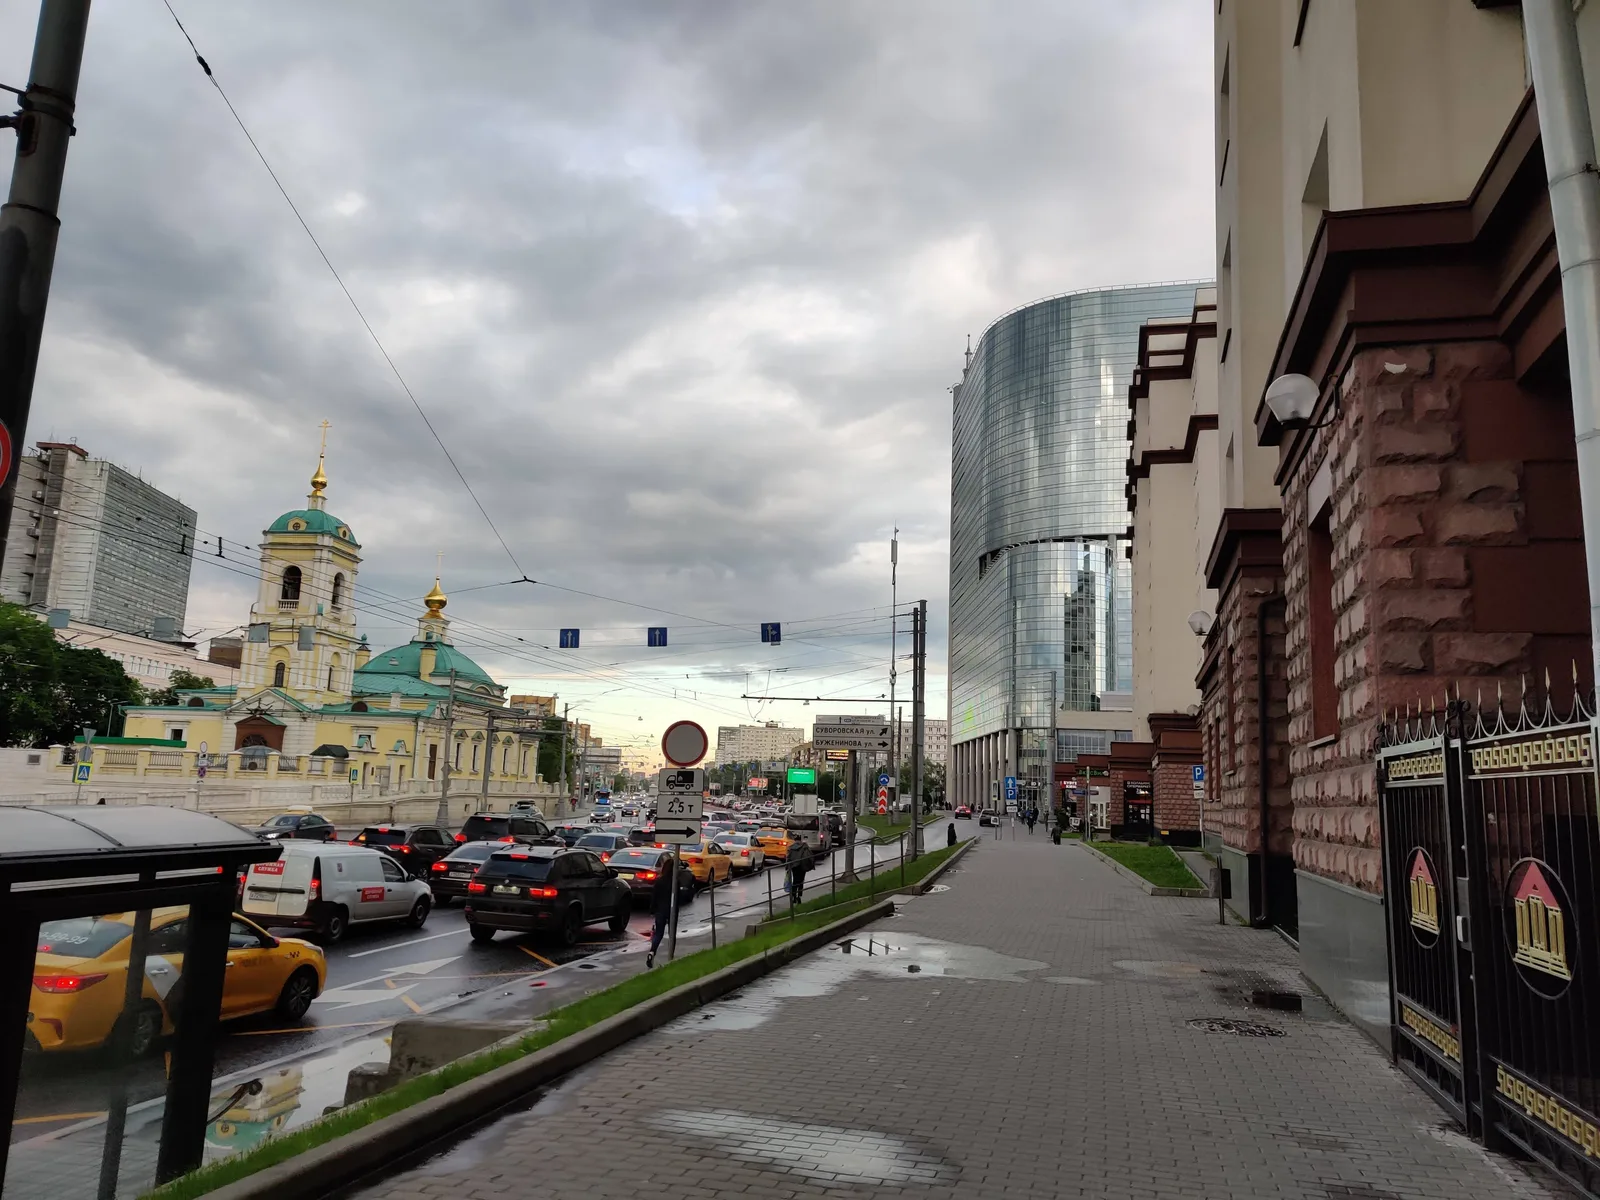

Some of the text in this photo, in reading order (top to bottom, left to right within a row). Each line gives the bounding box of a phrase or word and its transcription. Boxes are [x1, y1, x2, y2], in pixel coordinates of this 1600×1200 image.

[815, 739, 862, 747] БУЖЕНИНОВА
[1194, 767, 1202, 780] P
[1008, 789, 1015, 799] P
[668, 801, 685, 815] 2,5
